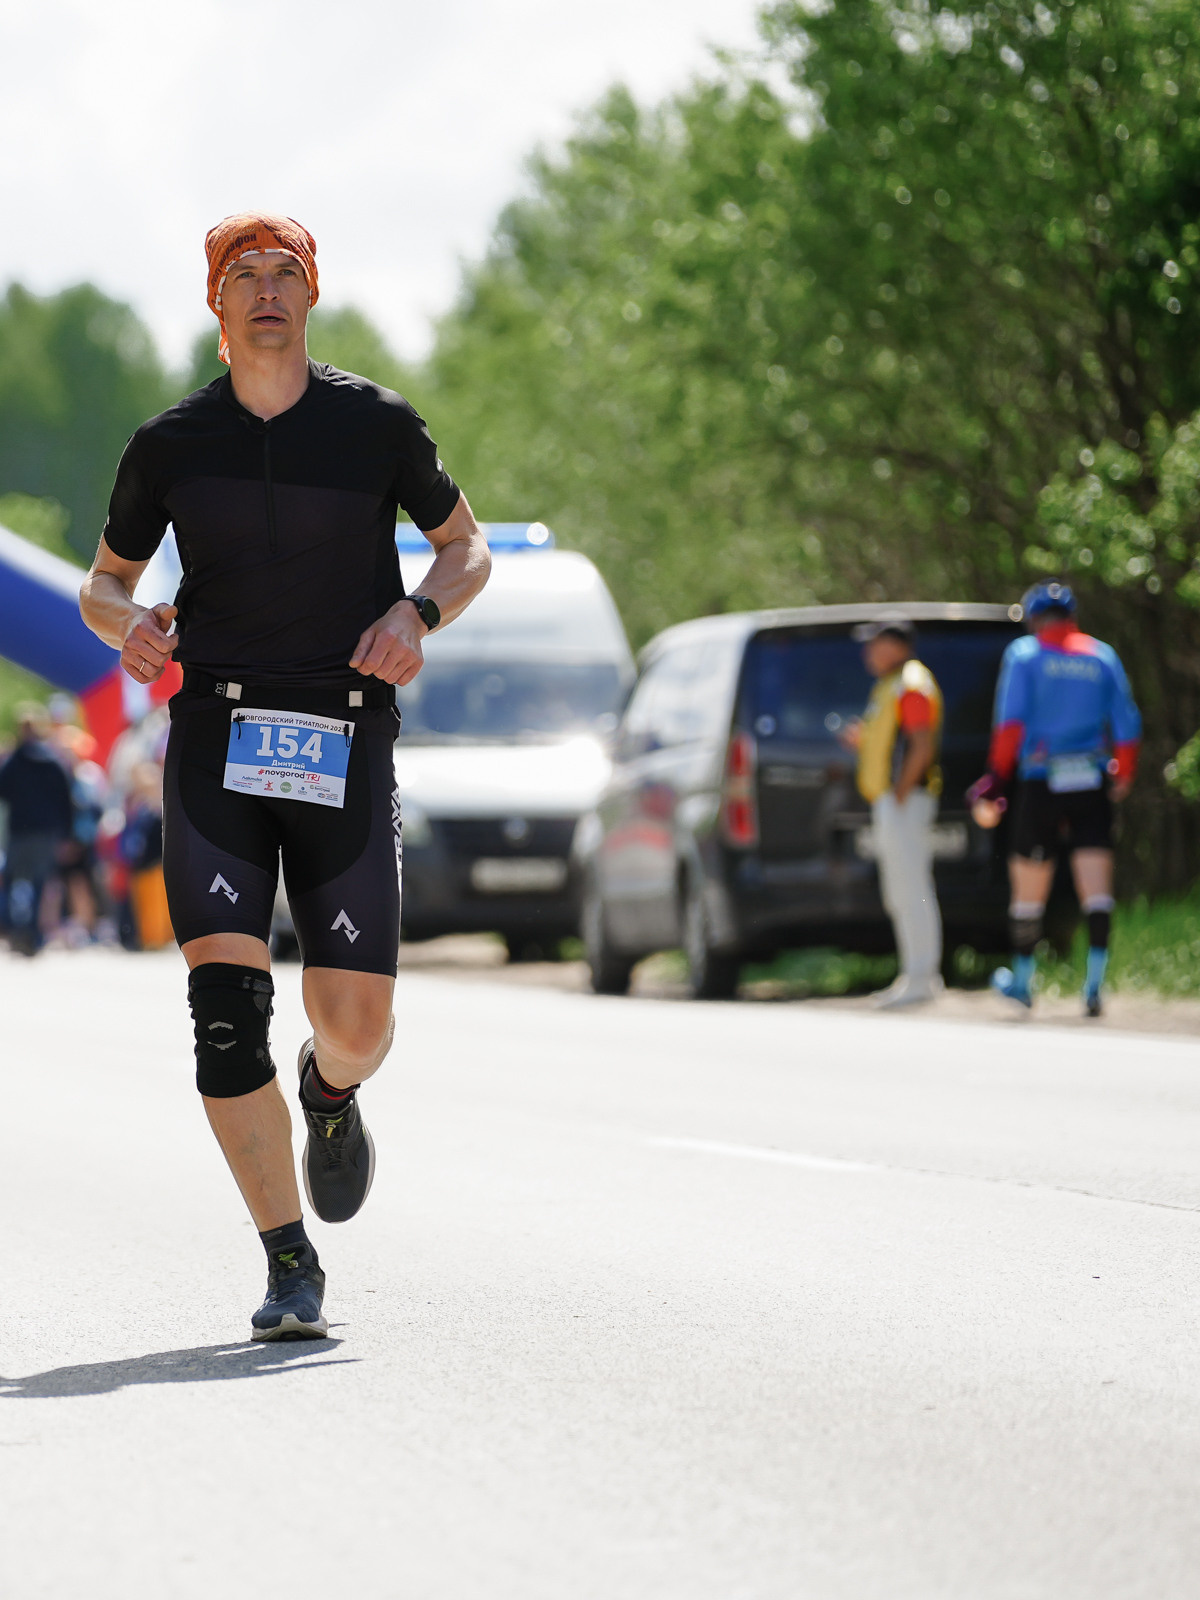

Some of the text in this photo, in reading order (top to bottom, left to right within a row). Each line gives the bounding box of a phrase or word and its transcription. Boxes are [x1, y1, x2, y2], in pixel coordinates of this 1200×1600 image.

[295, 719, 329, 729] ТРИАТЛОН
[256, 726, 323, 764] 154
[271, 759, 306, 770] Дмитрий
